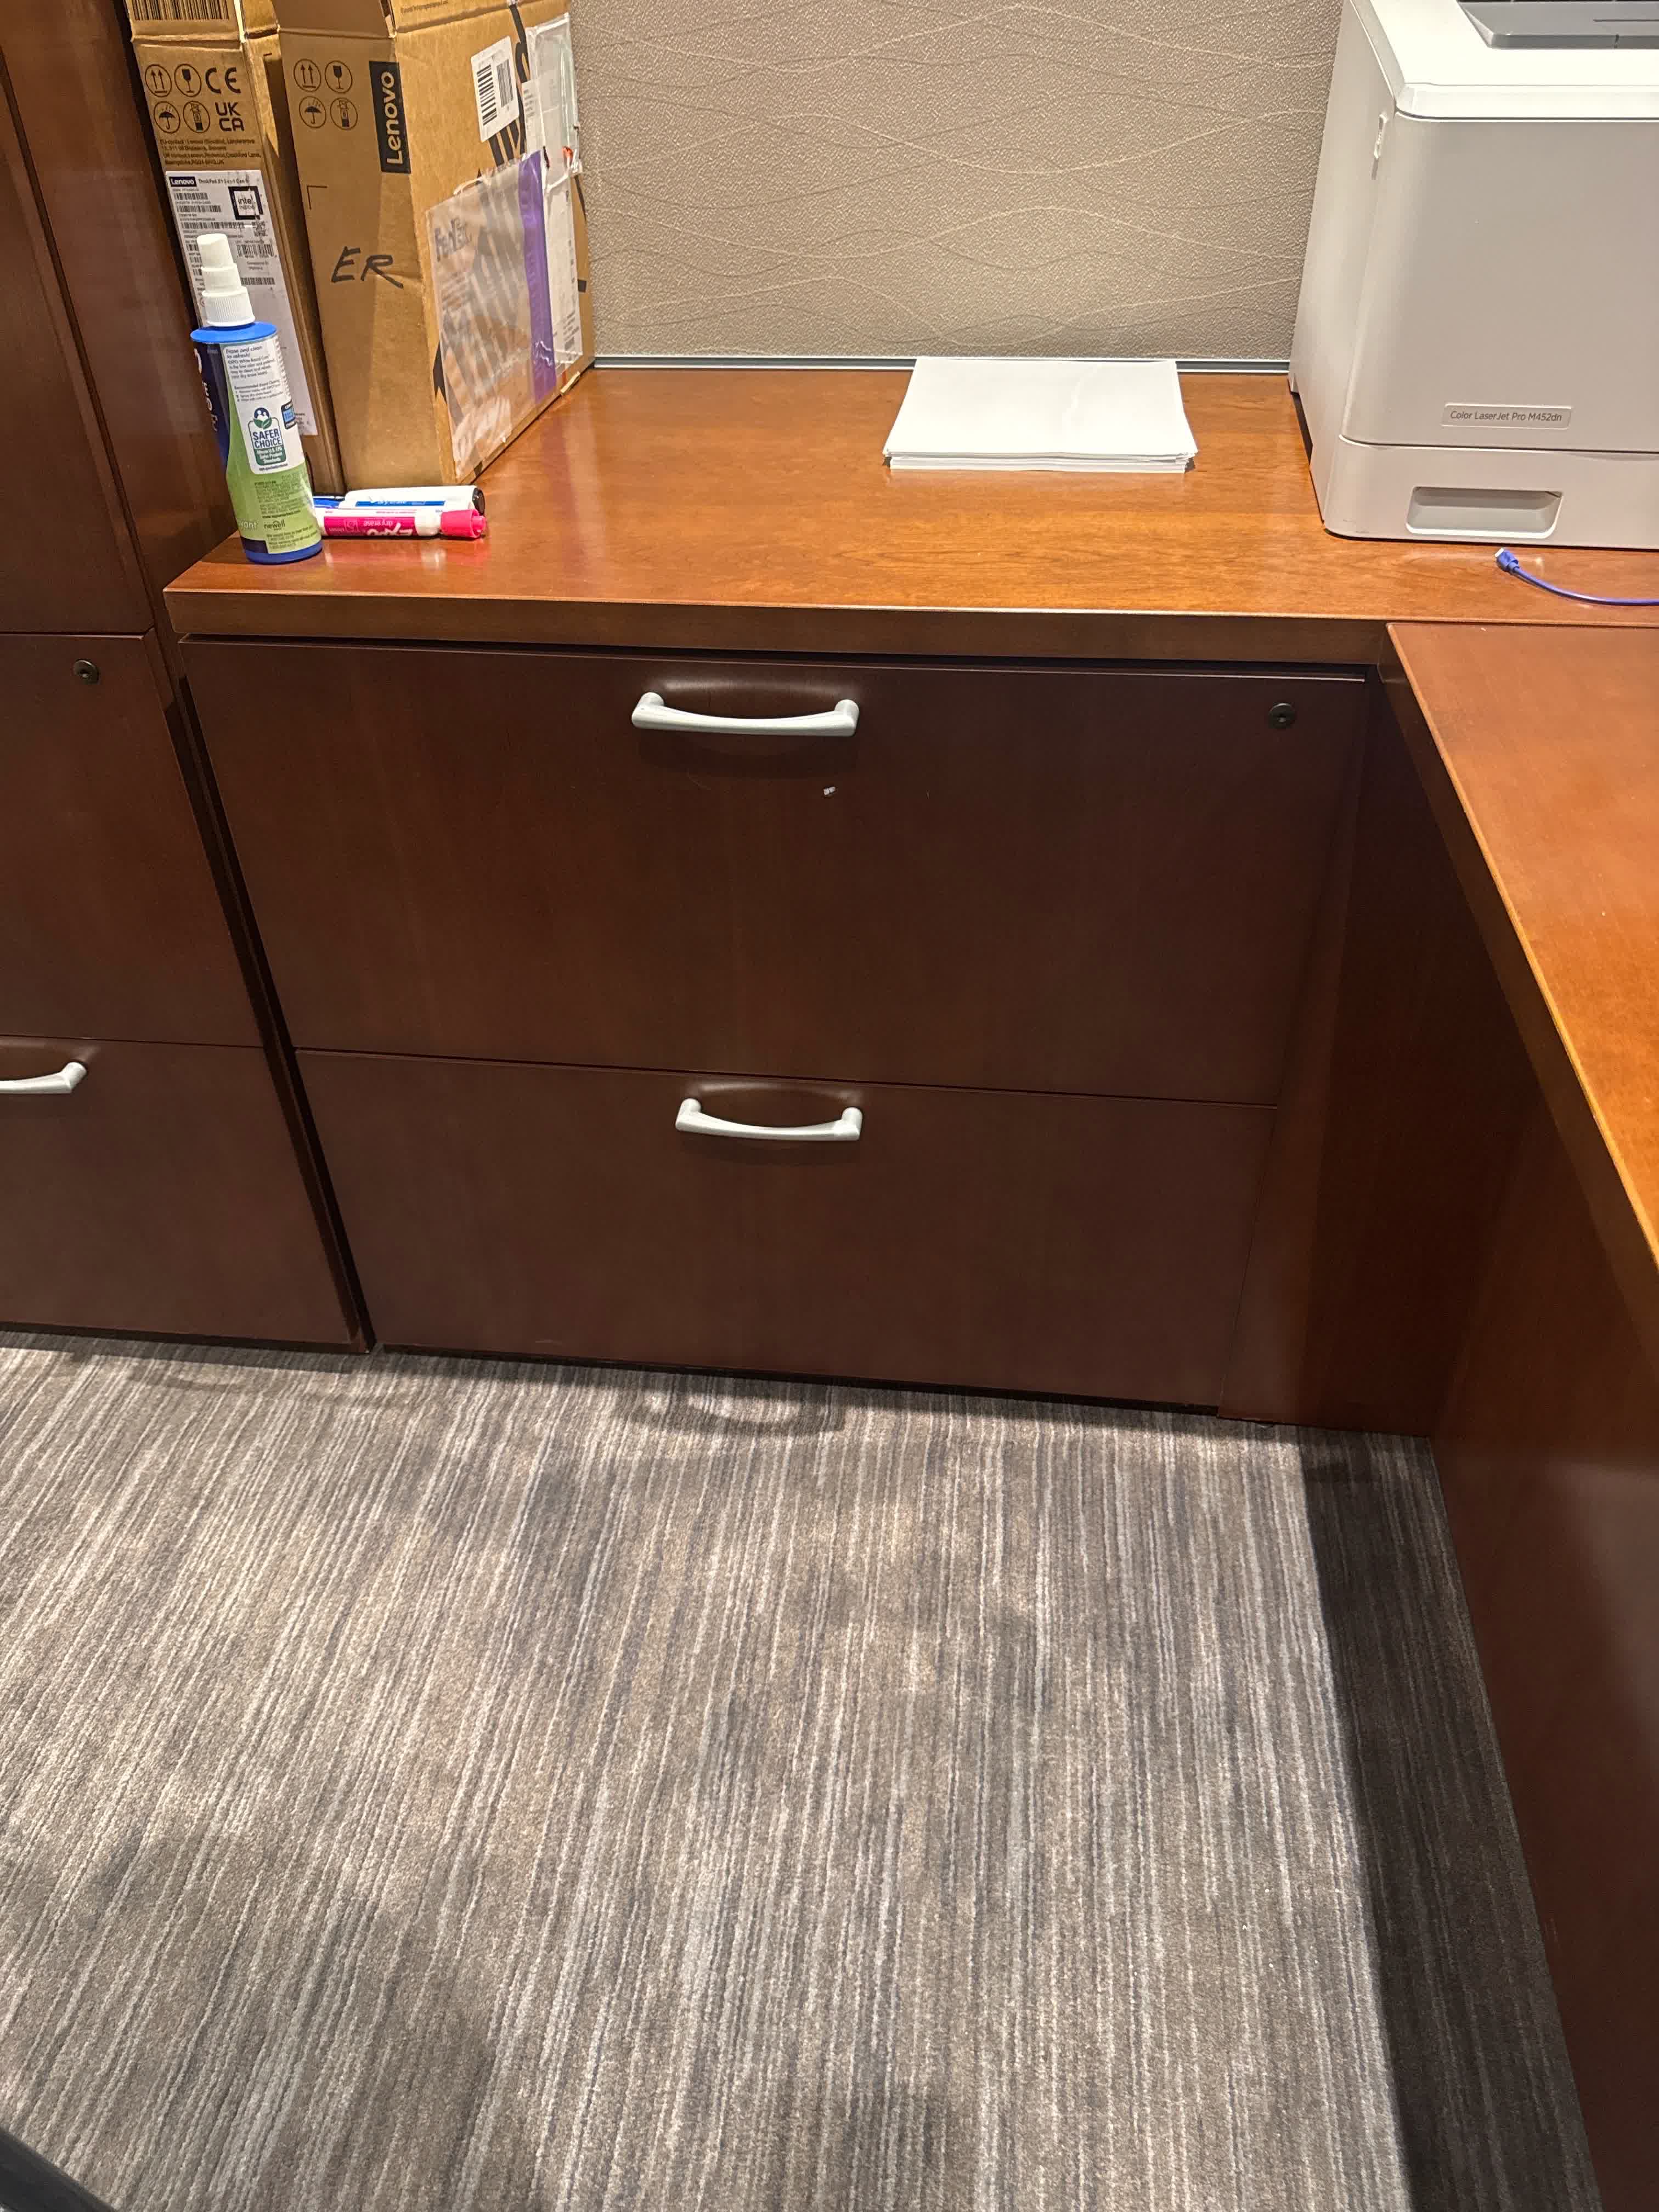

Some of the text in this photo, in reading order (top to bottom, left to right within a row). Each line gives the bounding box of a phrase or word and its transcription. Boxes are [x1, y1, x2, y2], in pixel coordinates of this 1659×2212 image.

[205, 66, 241, 95] CE
[215, 102, 240, 116] UK
[219, 117, 245, 132] CA
[380, 70, 404, 166] Lenovo
[331, 245, 404, 289] ER
[1450, 410, 1562, 422] Color LaserJet Pro M452dn
[252, 428, 280, 441] SAFER
[254, 437, 282, 449] CHOICE
